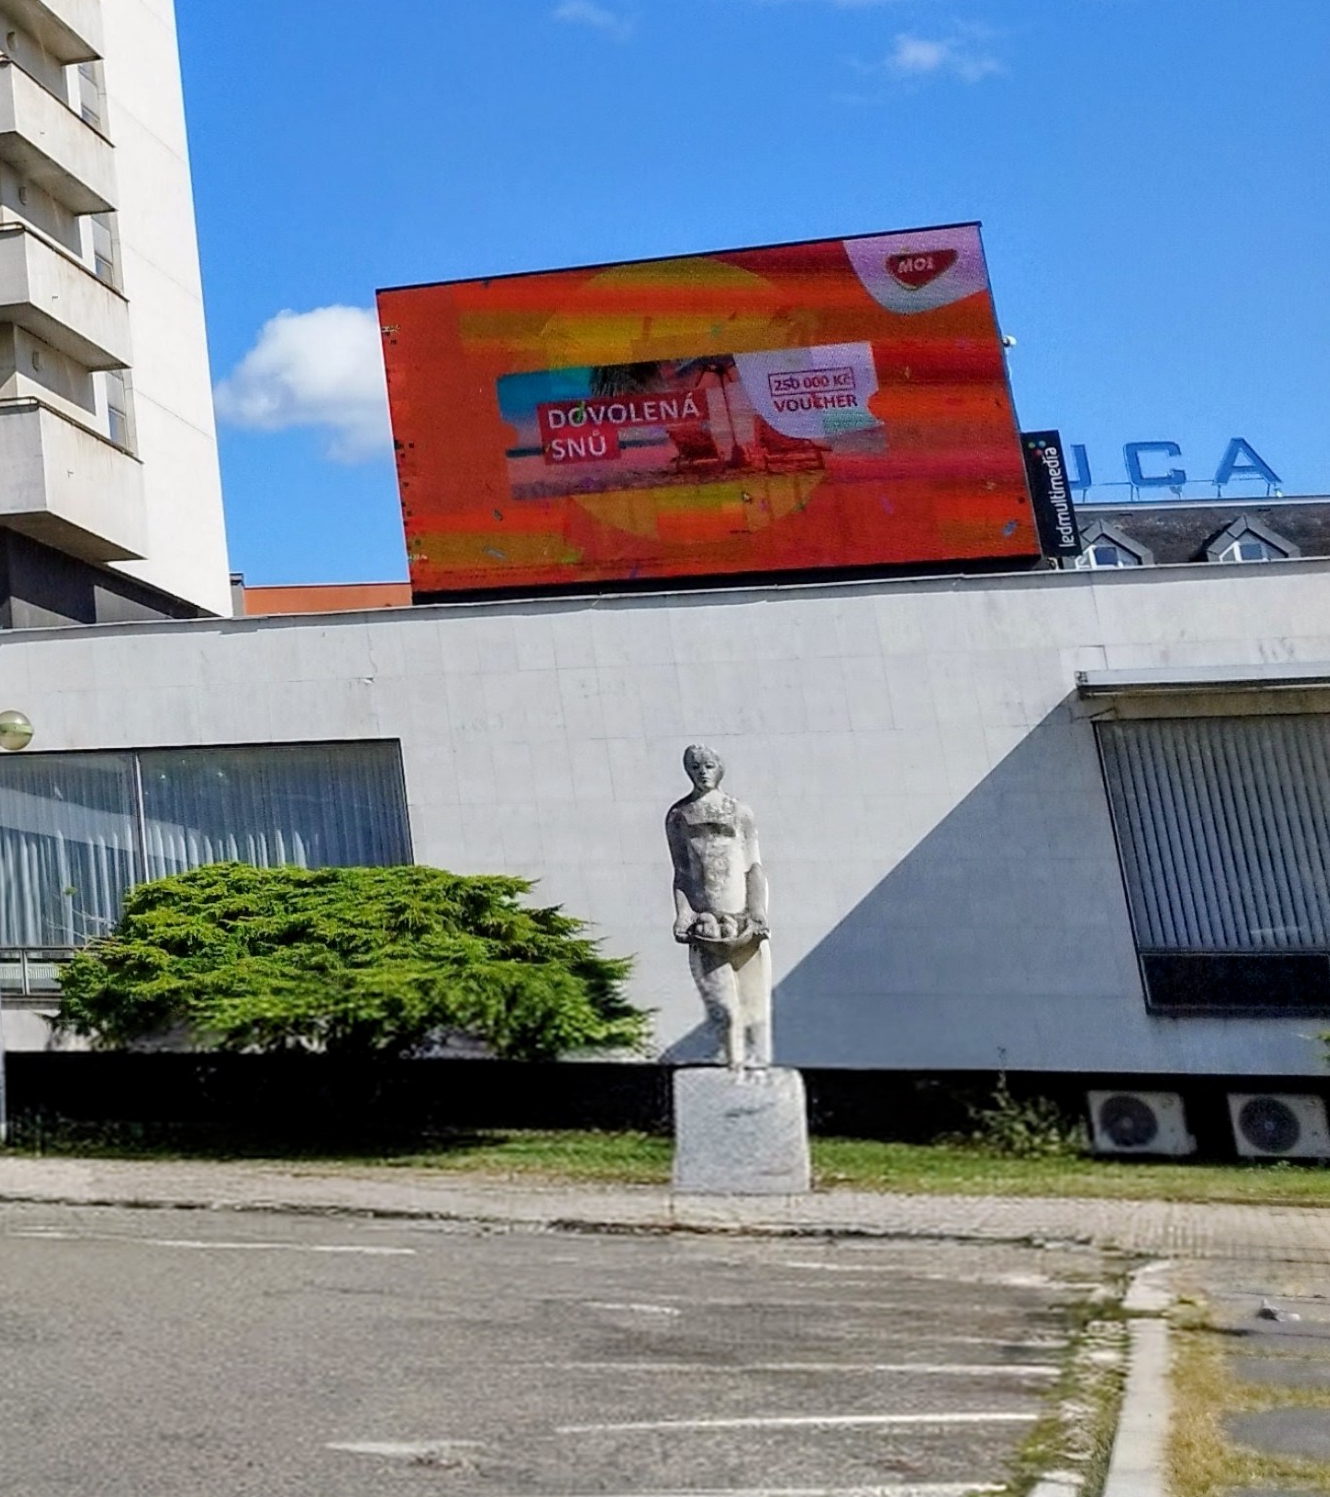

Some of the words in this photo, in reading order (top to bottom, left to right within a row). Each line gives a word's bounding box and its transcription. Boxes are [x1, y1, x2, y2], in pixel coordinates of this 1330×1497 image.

[774, 377, 800, 392] 250
[803, 375, 830, 390] 000
[548, 391, 701, 430] DOVOLENÁ
[774, 394, 859, 412] VOUCHER
[551, 429, 608, 460] SNŮ
[1044, 447, 1076, 548] ledmultimedia
